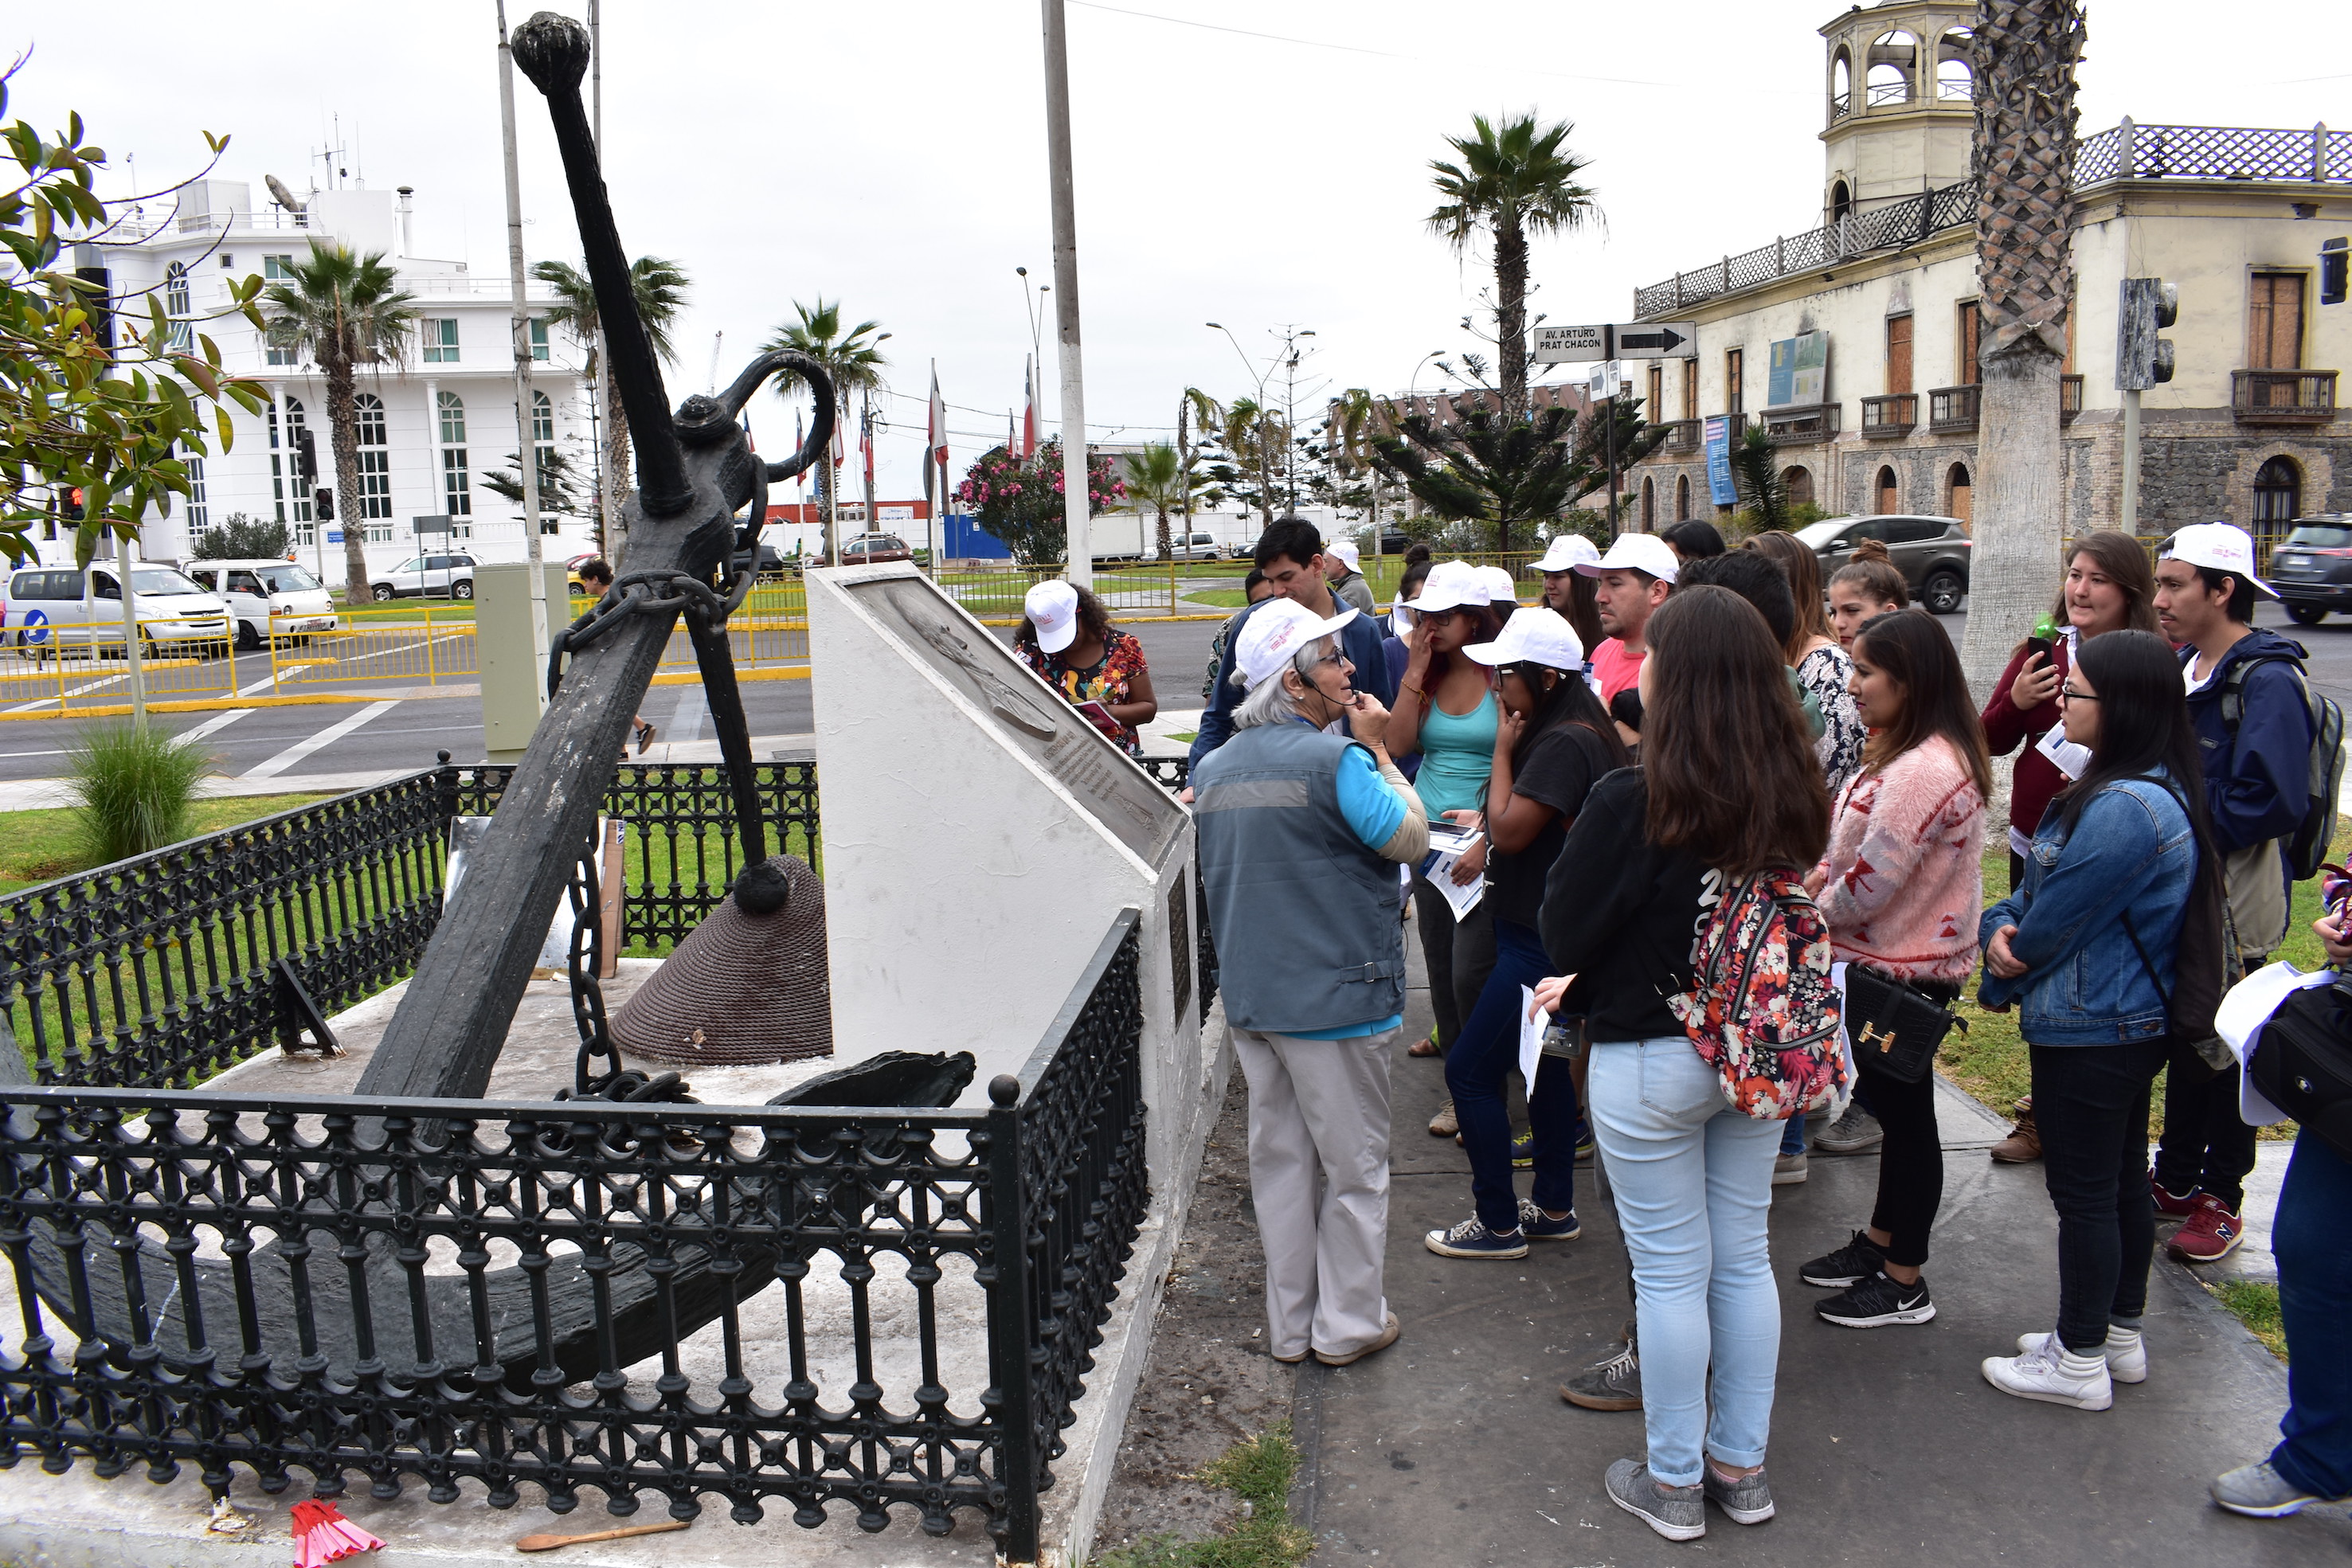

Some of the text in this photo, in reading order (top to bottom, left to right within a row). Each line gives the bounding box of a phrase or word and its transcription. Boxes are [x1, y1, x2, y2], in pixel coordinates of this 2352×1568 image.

[1545, 329, 1595, 339] AV. ARTURO
[1540, 339, 1601, 350] PRAT CHACON
